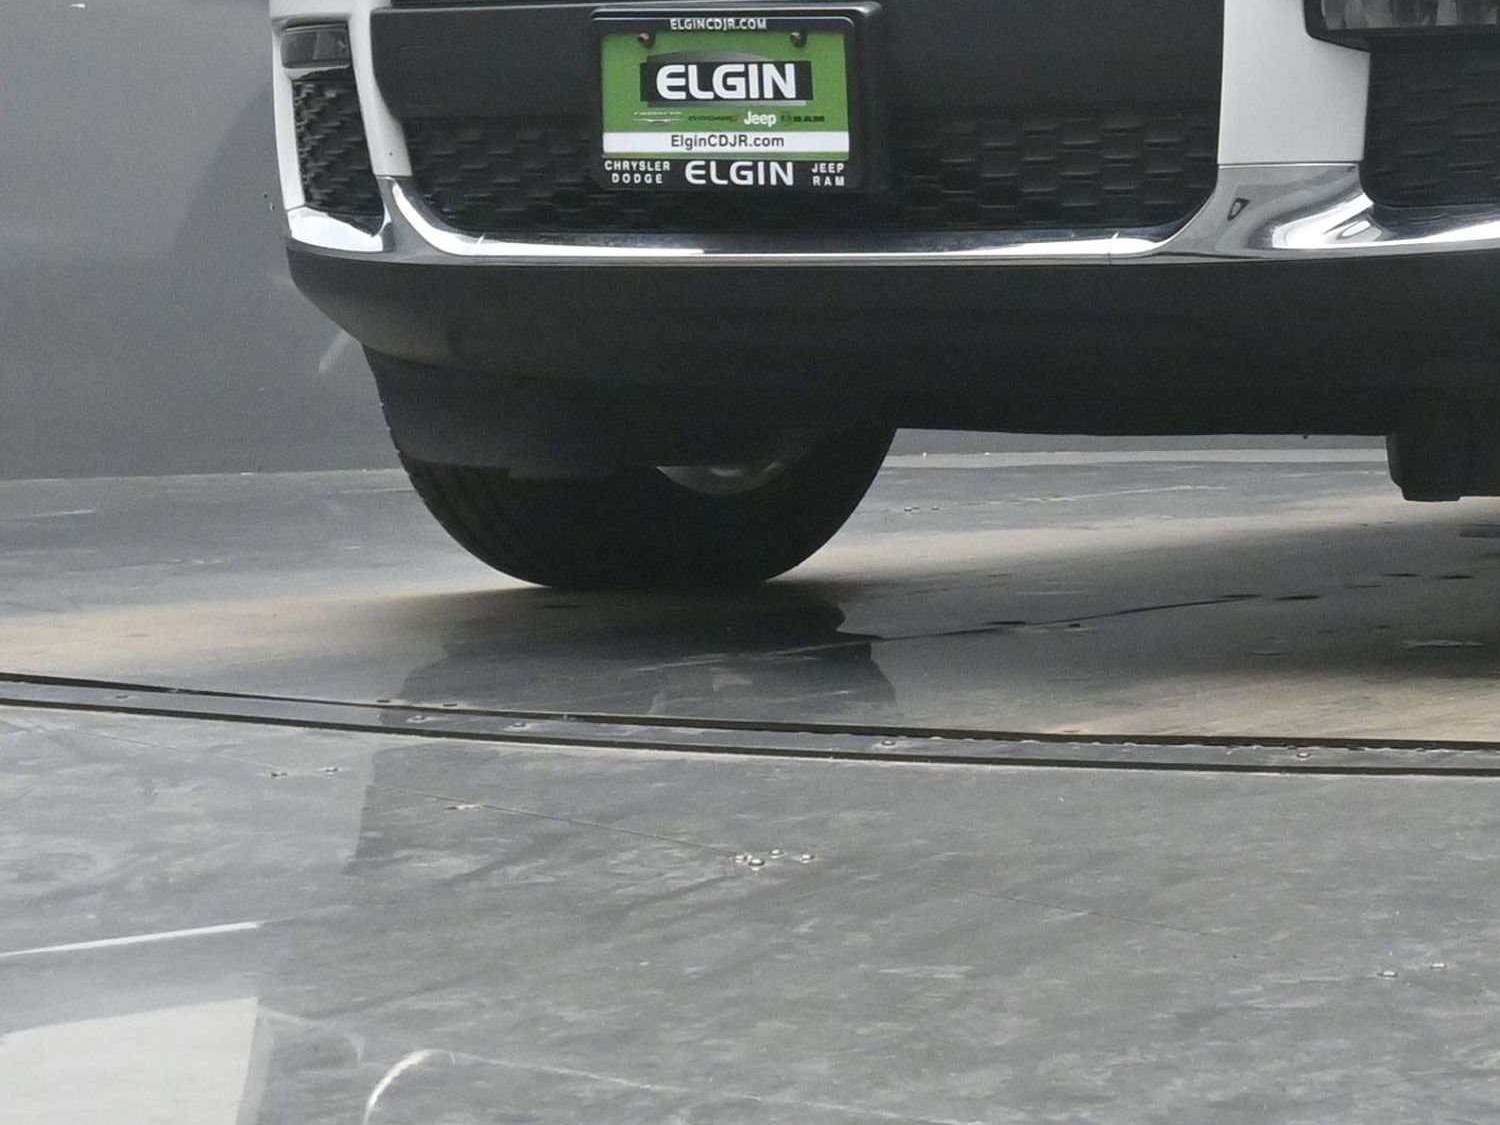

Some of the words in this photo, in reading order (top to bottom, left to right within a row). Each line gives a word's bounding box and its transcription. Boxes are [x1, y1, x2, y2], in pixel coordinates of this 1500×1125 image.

[670, 18, 767, 31] ELGINCDJR.COM
[656, 63, 796, 100] ELGIN
[743, 111, 777, 128] Jeep
[671, 134, 785, 150] ElginCDJR.com
[604, 159, 670, 172] CHRYSLER
[811, 162, 845, 174] JEEP
[612, 172, 663, 184] DODGE
[685, 160, 794, 186] ELGIN
[812, 175, 845, 187] RAM
